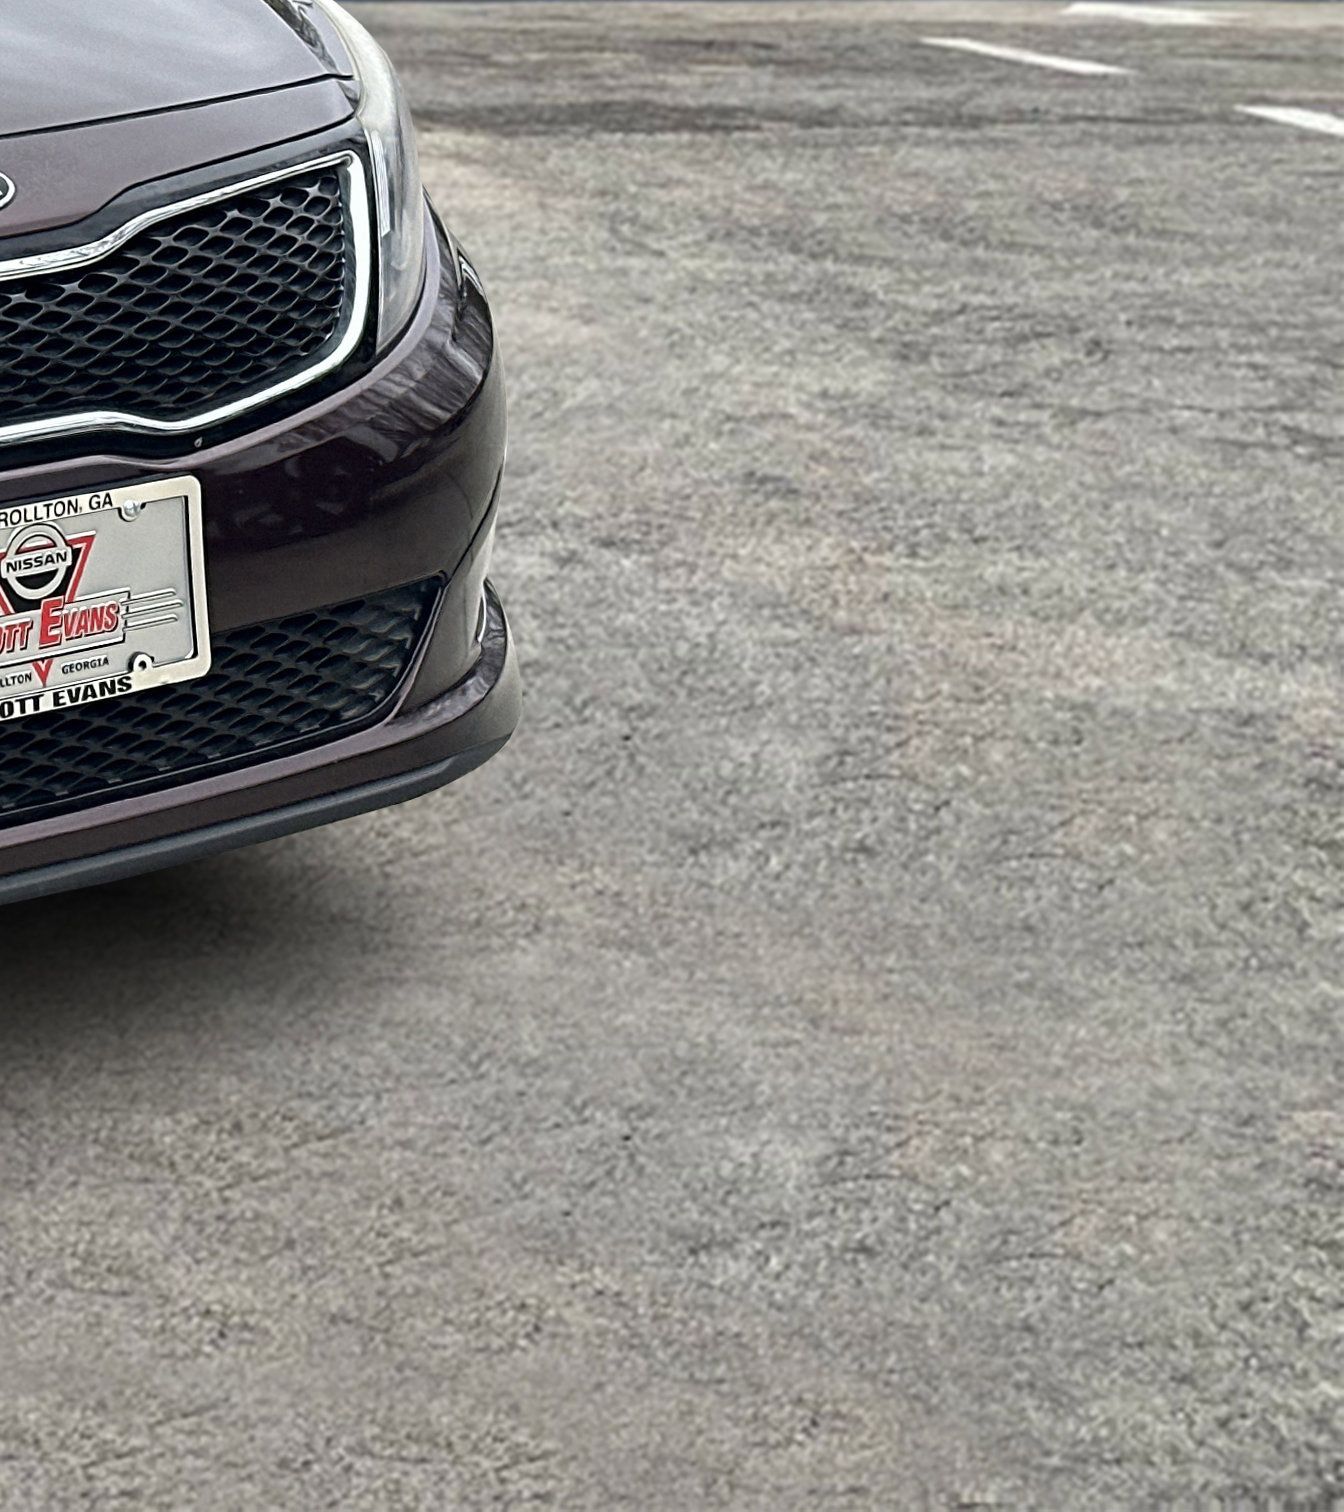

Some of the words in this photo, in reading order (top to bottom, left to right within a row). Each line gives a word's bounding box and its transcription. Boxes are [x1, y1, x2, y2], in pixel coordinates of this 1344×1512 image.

[88, 492, 114, 511] GA
[5, 550, 68, 574] NISSAN
[38, 596, 120, 650] EVANS
[62, 656, 110, 675] GEORGIA
[53, 675, 133, 708] EVANS
